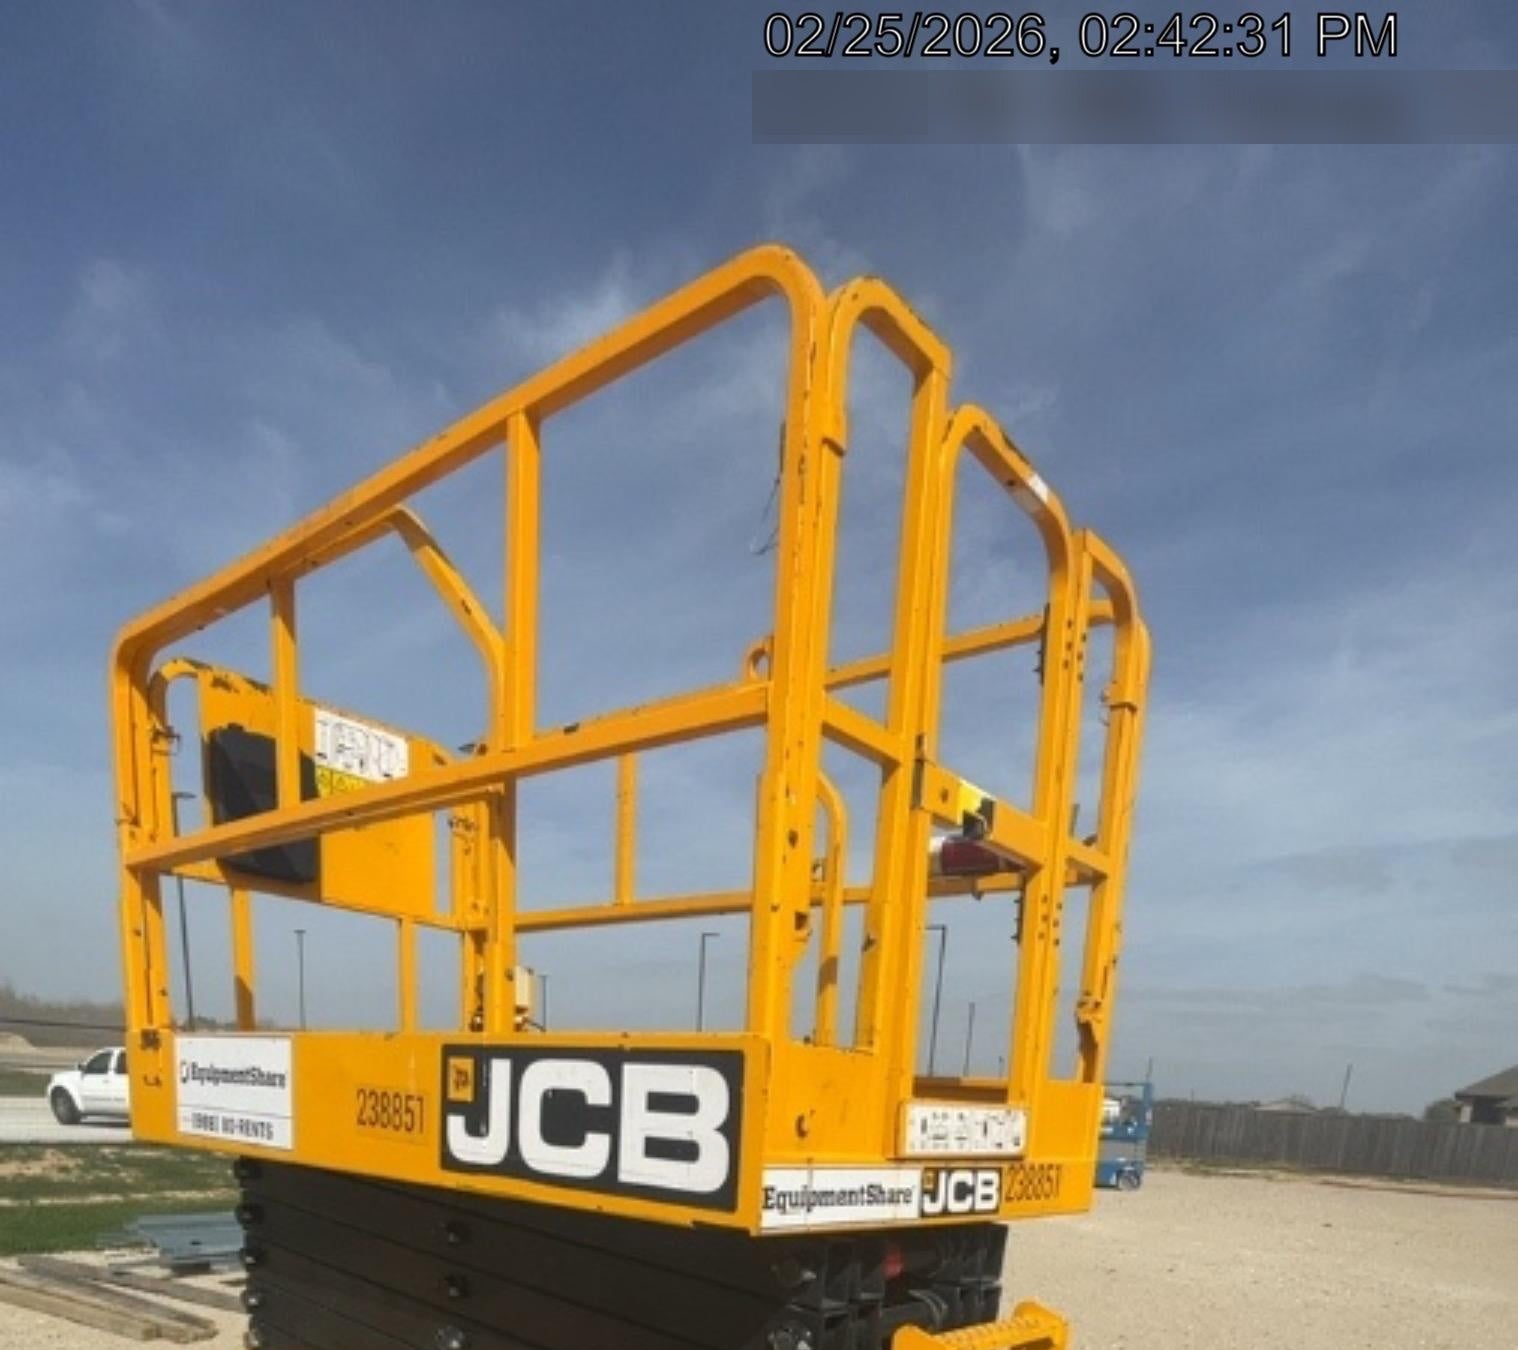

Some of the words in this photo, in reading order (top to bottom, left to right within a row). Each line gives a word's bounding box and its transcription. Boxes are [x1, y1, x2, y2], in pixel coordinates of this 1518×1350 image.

[192, 1062, 286, 1088] EquipmentShare
[357, 1088, 424, 1134] 238851
[446, 1058, 731, 1193] JCB
[762, 1183, 913, 1213] EquipmentShare
[922, 1169, 999, 1214] JCB
